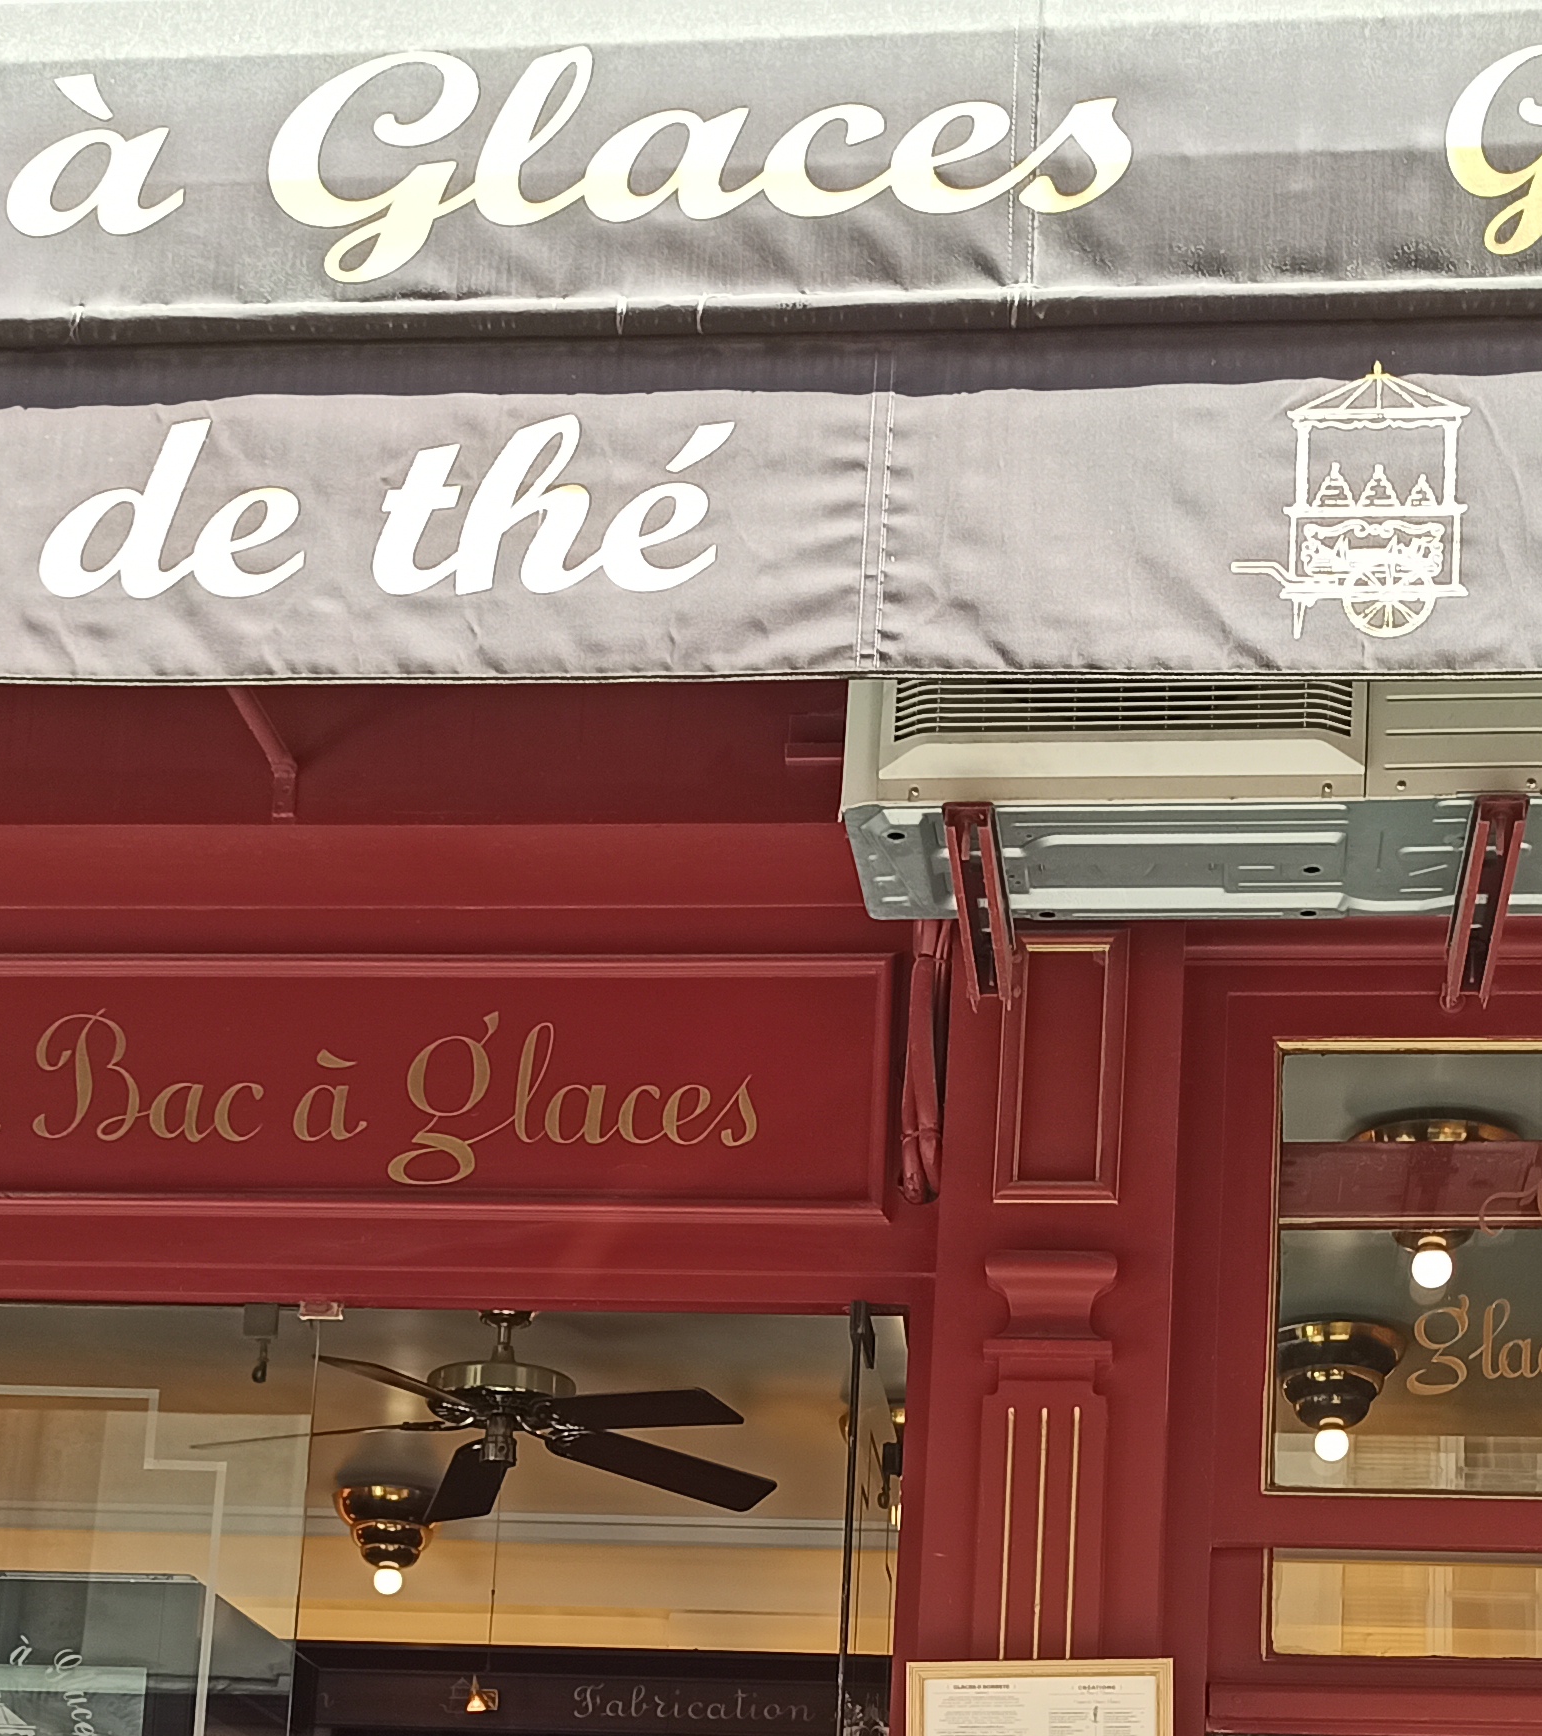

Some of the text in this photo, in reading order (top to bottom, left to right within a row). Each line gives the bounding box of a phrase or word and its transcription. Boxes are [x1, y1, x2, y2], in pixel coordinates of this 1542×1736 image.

[7, 74, 184, 238] à
[267, 45, 1134, 284] Glaces
[37, 416, 307, 600] de
[371, 412, 736, 597] thé
[32, 1008, 263, 1143] Bac
[292, 1049, 367, 1140] à
[9, 1634, 33, 1667] à
[573, 1683, 815, 1721] Fabrication
